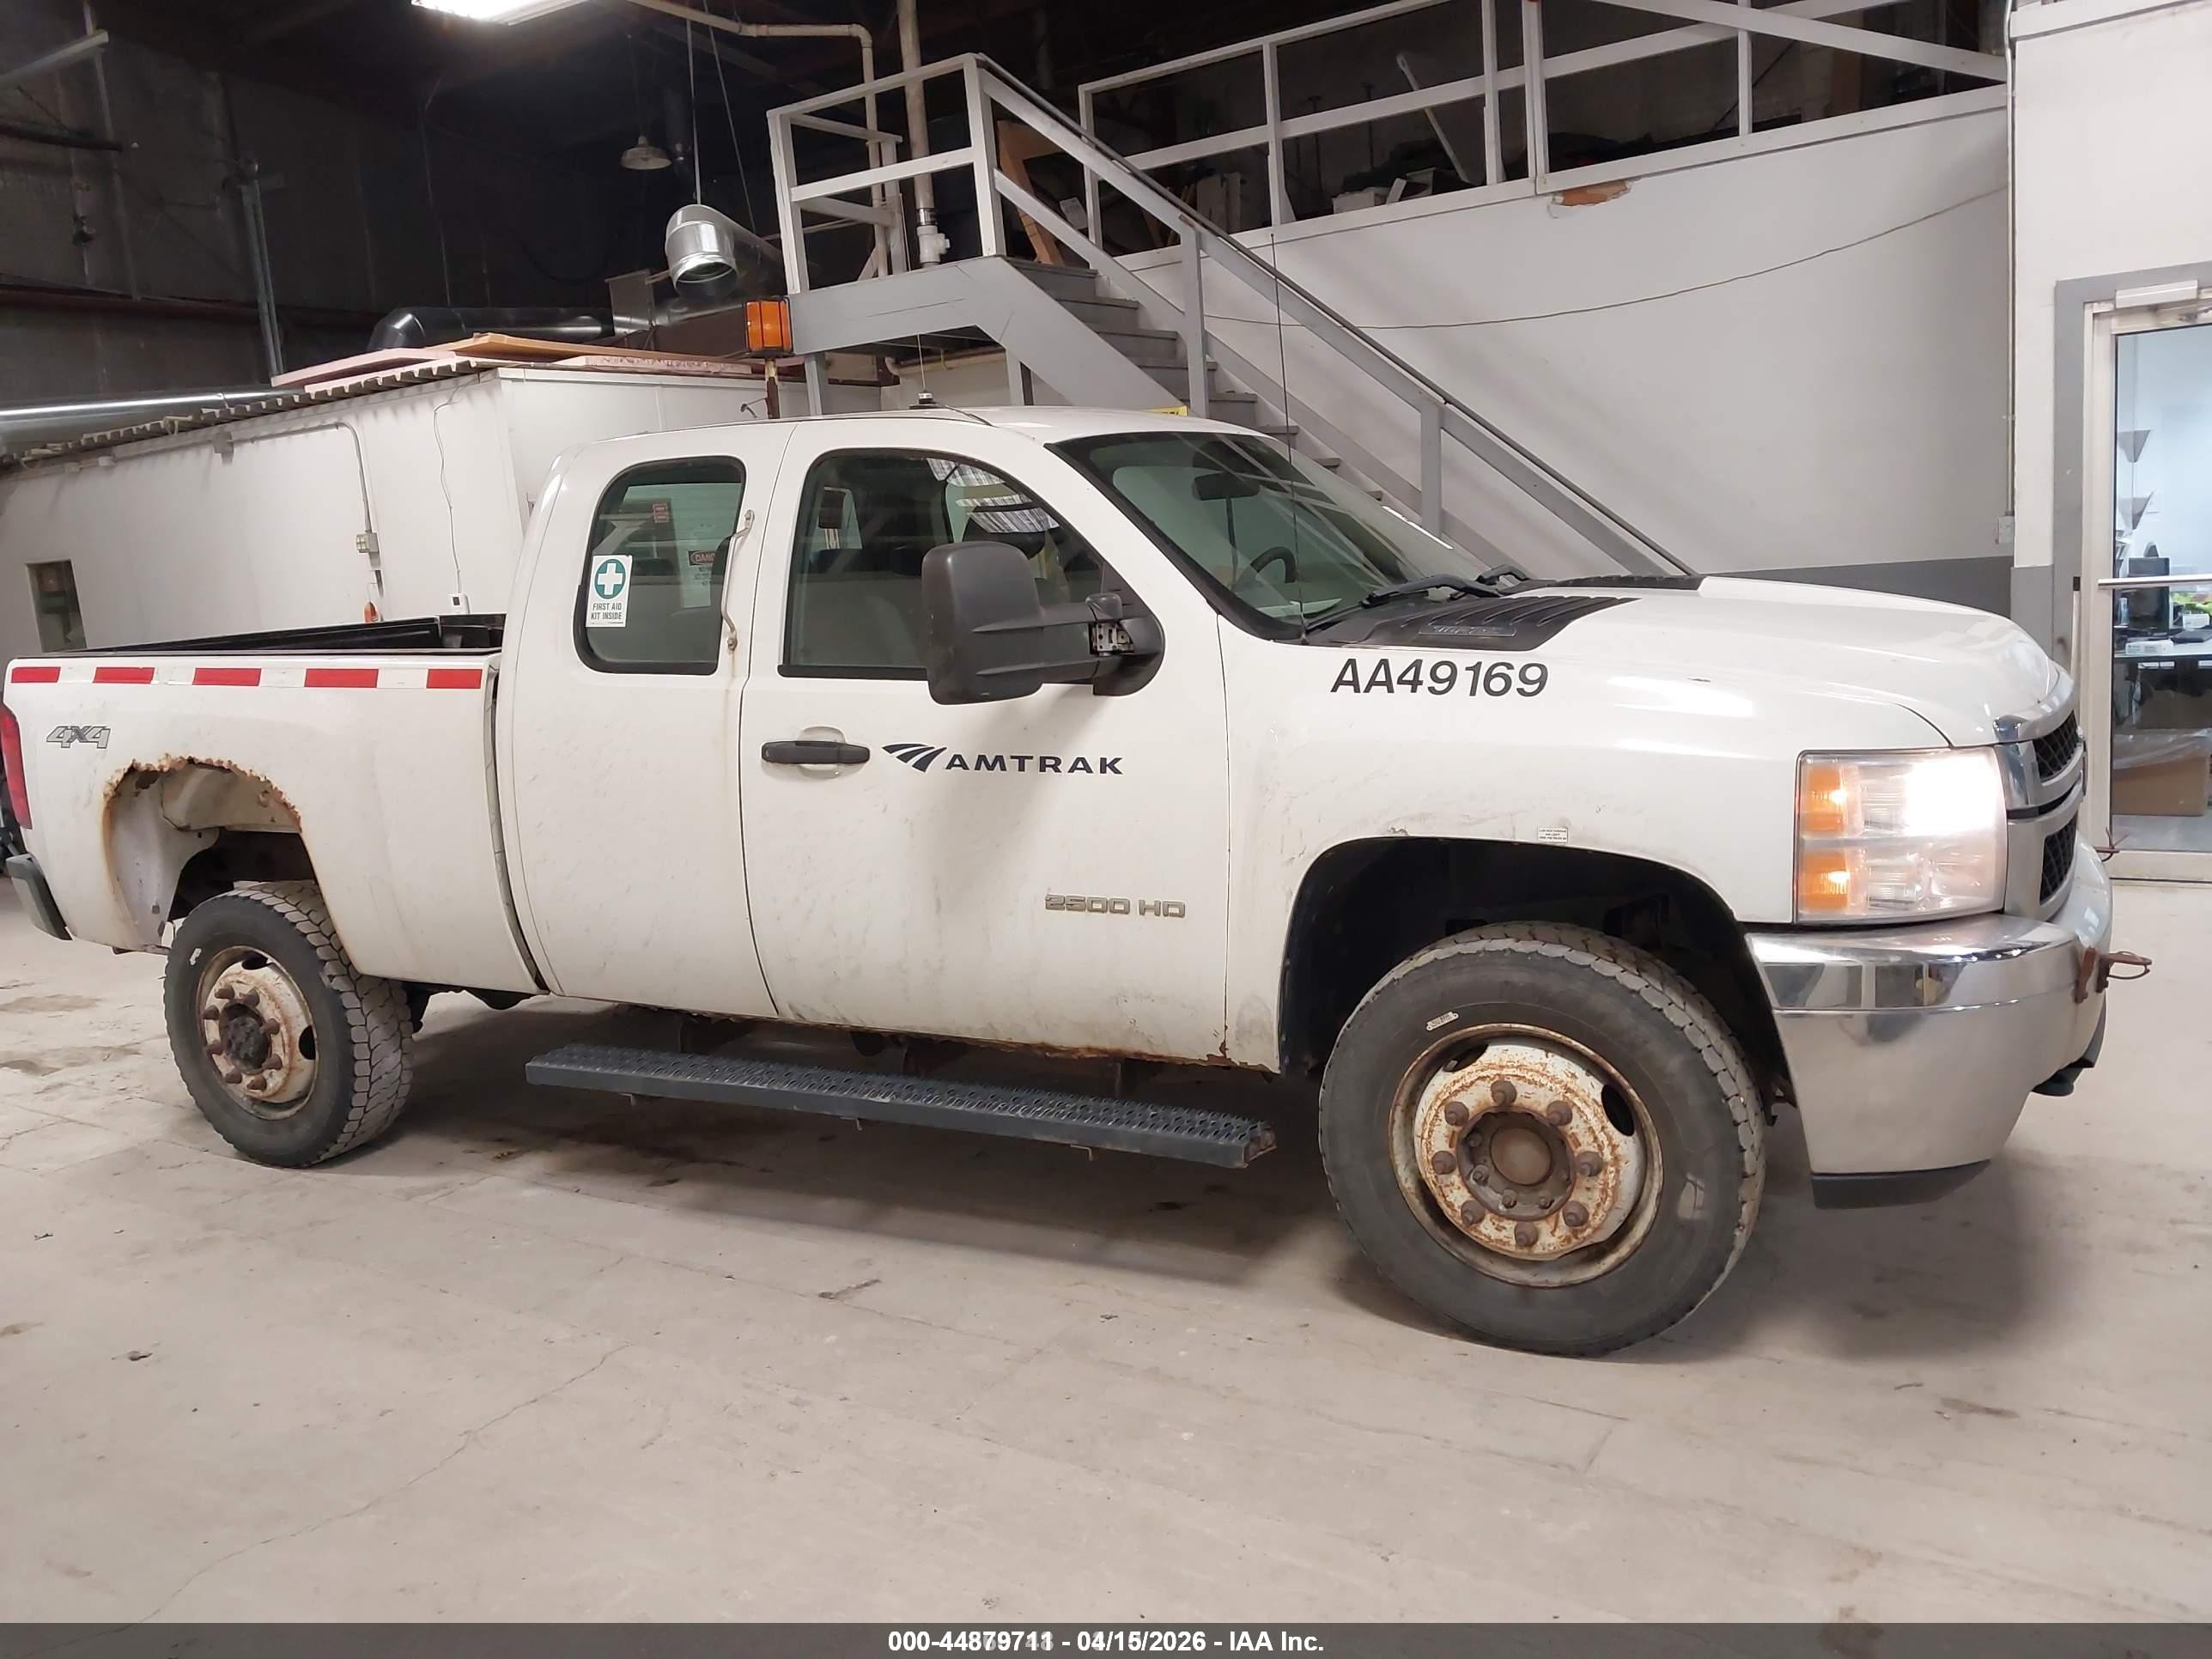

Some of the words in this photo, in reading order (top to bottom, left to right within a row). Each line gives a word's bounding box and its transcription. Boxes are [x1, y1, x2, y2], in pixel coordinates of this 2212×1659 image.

[591, 611, 601, 620] KIT
[603, 611, 623, 620] INSIDE
[592, 602, 611, 611] FIRST
[611, 602, 623, 611] AID
[1331, 658, 1548, 697] AA49169
[945, 753, 1124, 775] AMTRAK
[1045, 894, 1131, 915] 2500
[1139, 899, 1186, 919] HD
